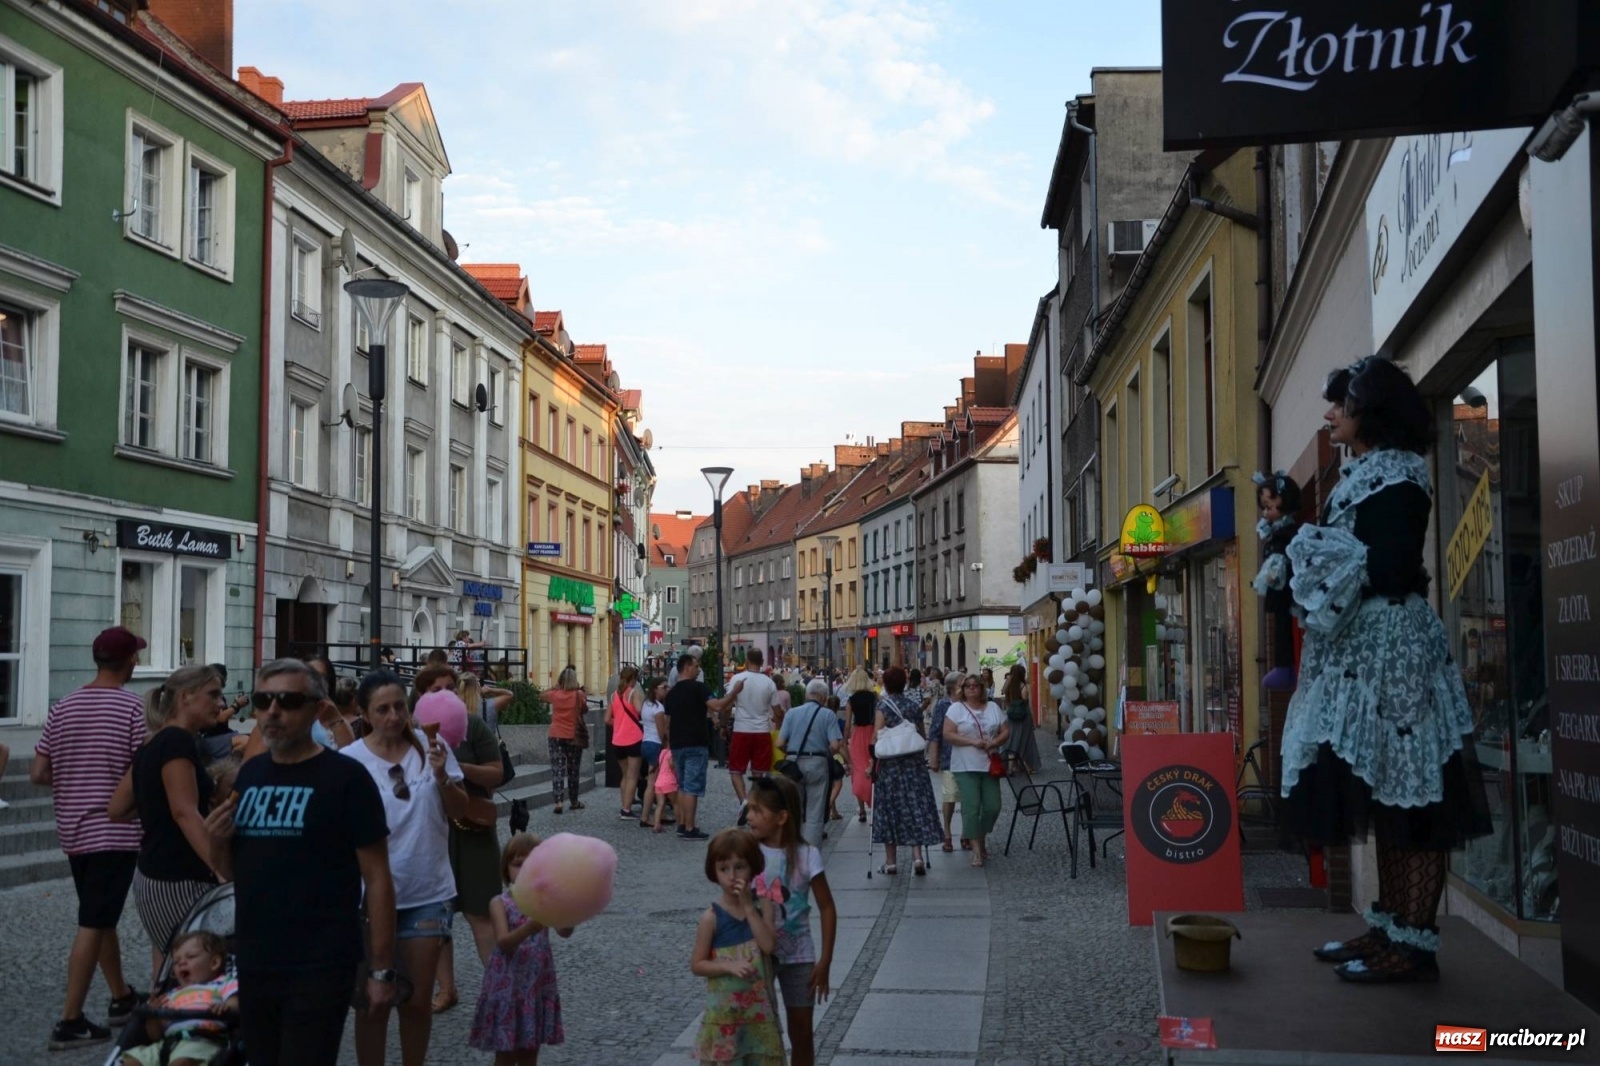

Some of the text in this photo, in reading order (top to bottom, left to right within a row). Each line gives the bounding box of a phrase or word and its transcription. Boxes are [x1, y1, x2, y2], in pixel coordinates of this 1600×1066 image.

[1222, 2, 1477, 91] Złotnik
[137, 525, 219, 554] Butik Lamar
[1124, 542, 1166, 553] żabka
[1548, 524, 1597, 569] SPRZEDAŻ
[1560, 654, 1600, 682] SREBRA
[1183, 770, 1214, 791] DRAK
[1165, 847, 1204, 860] bistro
